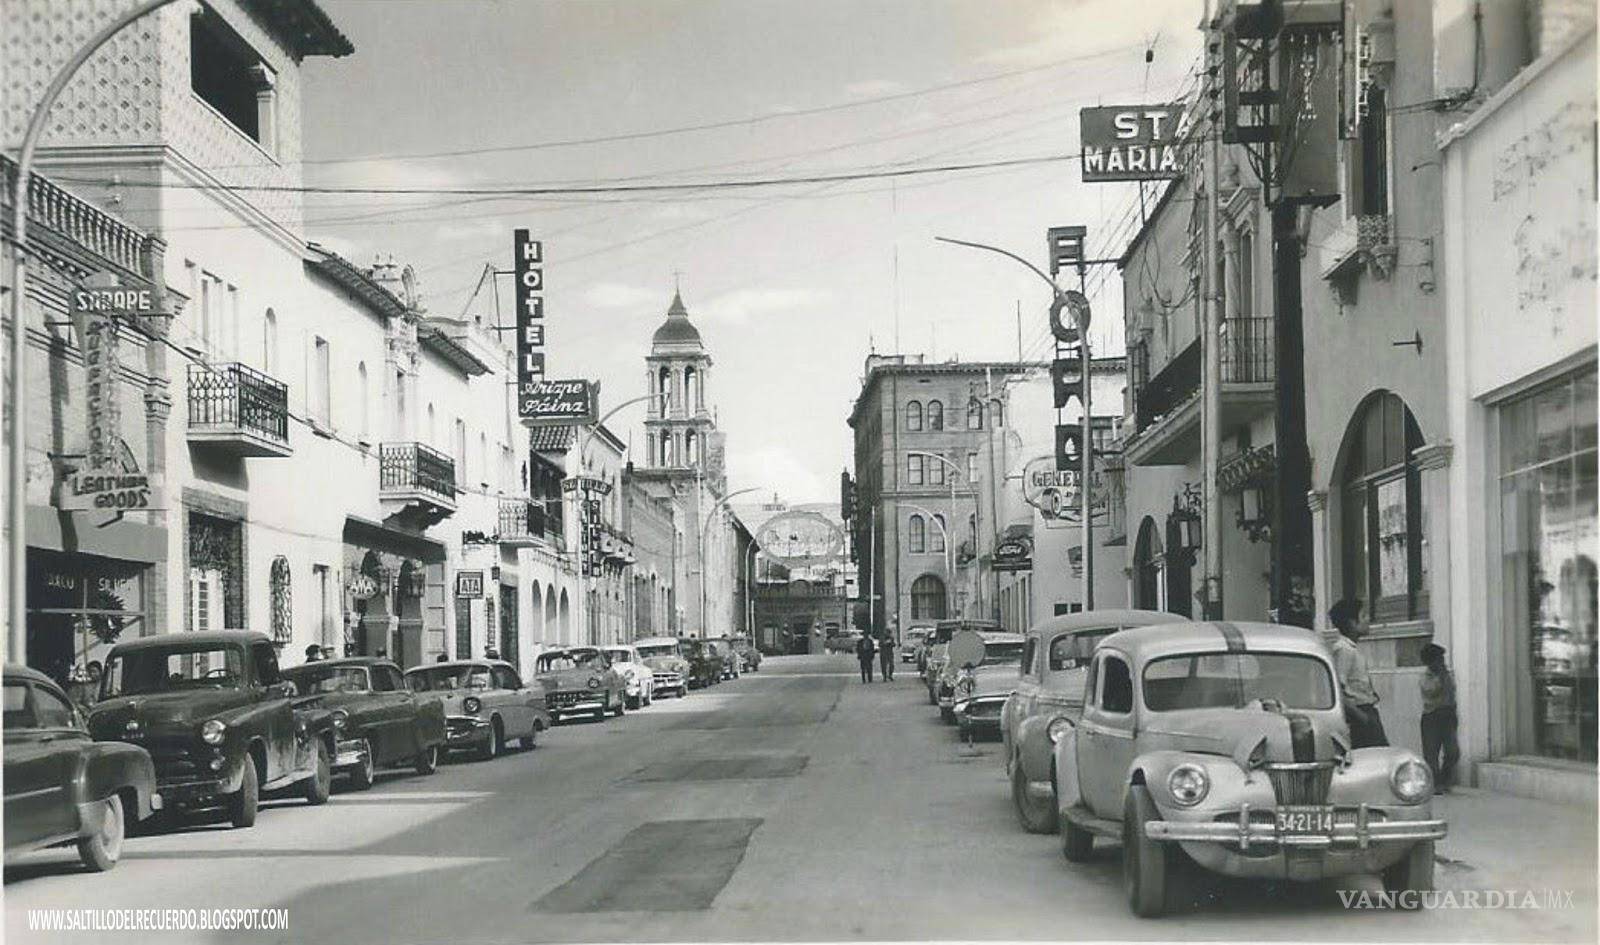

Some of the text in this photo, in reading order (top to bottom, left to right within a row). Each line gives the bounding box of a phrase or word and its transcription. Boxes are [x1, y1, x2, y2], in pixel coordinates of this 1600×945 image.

[1083, 145, 1177, 172] MARIA
[77, 290, 151, 311] SARAPE
[523, 242, 541, 373] HOTEL
[1048, 225, 1092, 472] FORD
[73, 476, 148, 496] LEATHER
[94, 489, 151, 508] GOODS
[1278, 813, 1332, 831] 34-21-14
